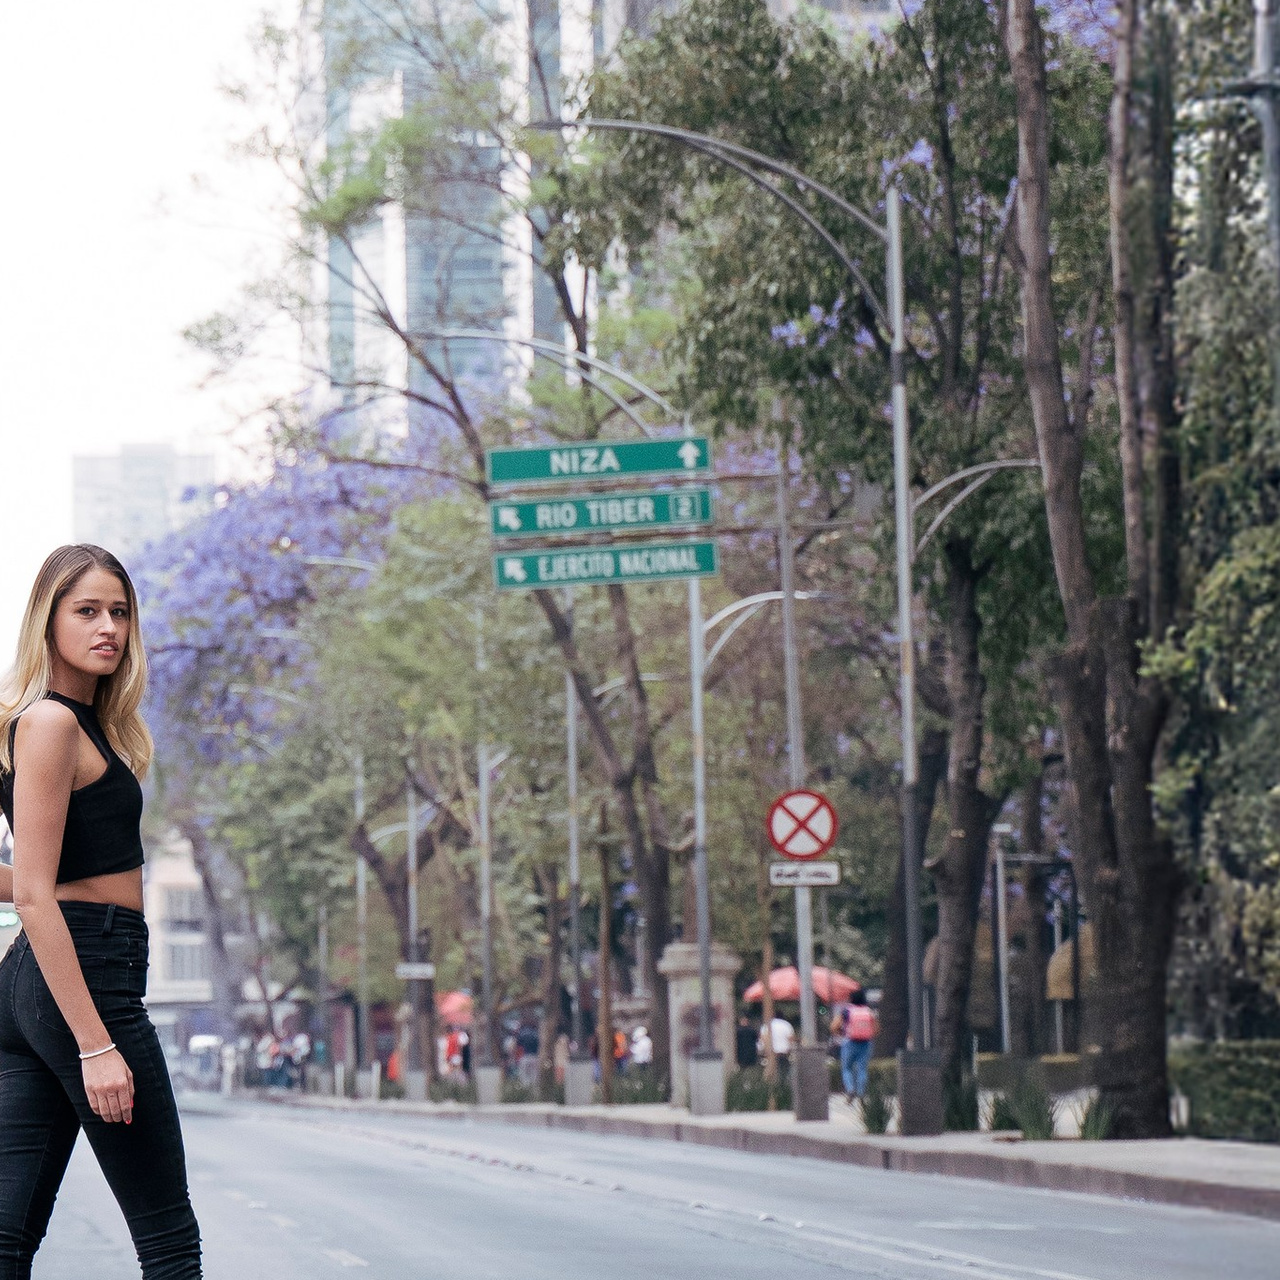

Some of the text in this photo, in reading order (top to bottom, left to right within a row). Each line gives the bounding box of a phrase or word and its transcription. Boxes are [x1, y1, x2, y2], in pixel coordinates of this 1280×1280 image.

[550, 448, 621, 475] NIZA
[536, 502, 578, 529] RIO
[586, 496, 656, 525] TIBER
[537, 546, 701, 582] EJERCITO NACIONAL
